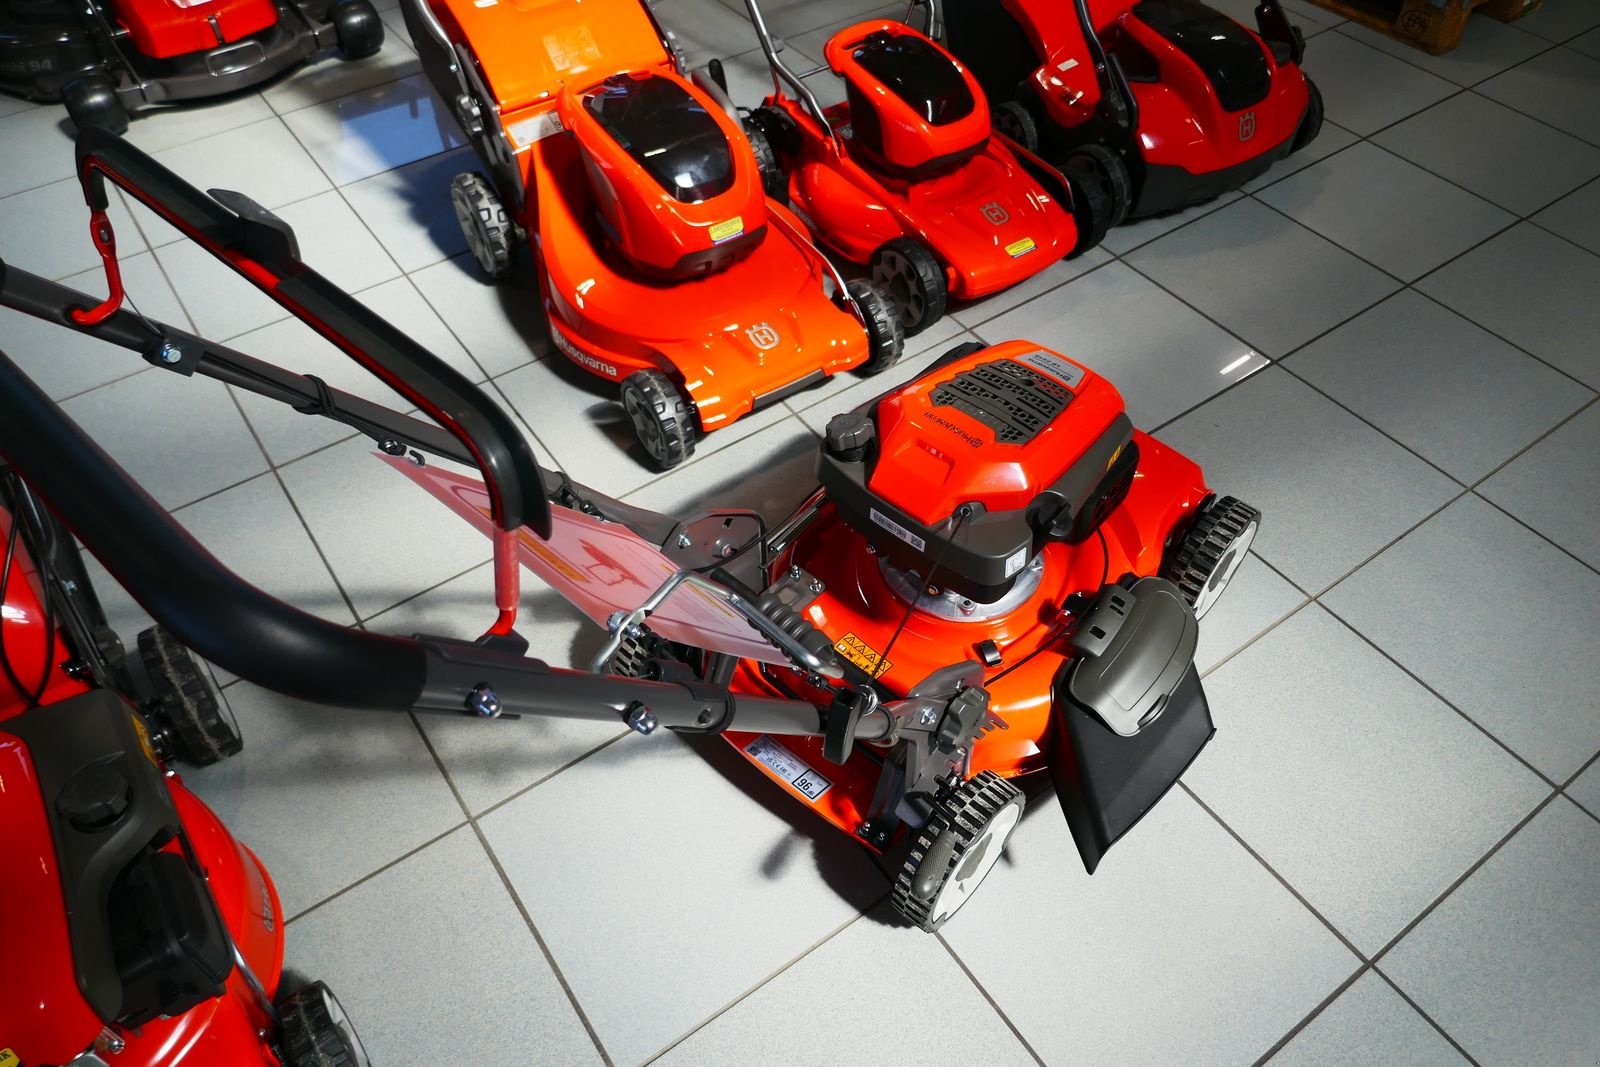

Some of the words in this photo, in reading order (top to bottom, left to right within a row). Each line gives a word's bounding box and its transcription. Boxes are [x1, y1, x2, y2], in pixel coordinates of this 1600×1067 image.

[29, 59, 53, 72] 94
[559, 336, 617, 376] Husqvarna
[797, 778, 812, 791] 96
